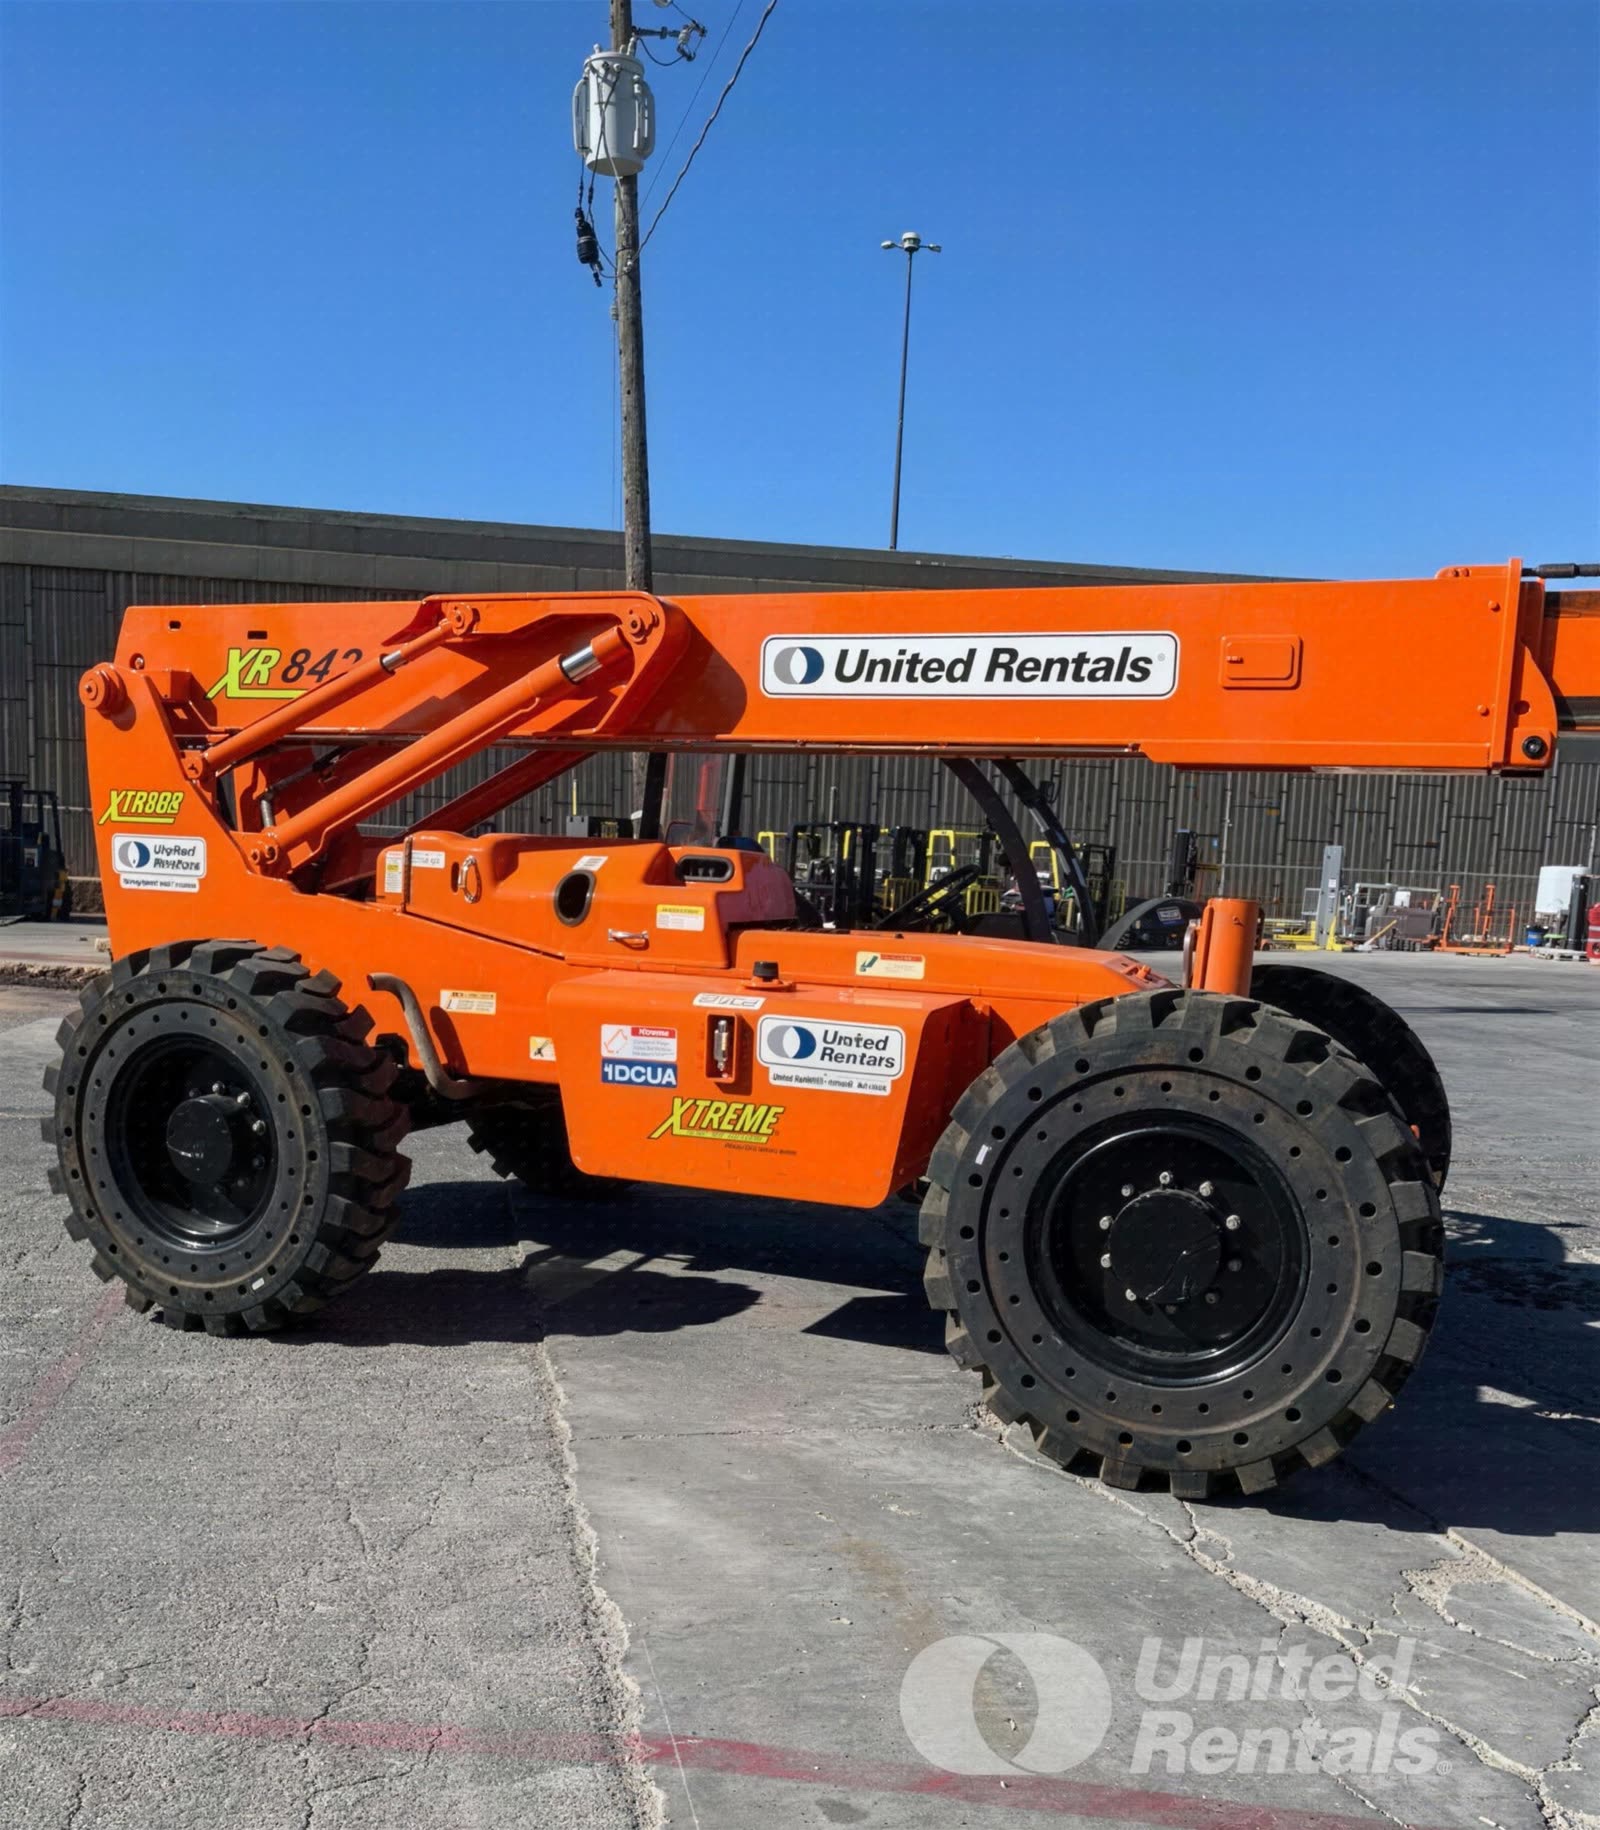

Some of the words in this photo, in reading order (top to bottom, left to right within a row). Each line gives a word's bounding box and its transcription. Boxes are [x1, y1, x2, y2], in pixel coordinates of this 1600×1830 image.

[834, 647, 977, 684] United
[984, 646, 1153, 684] Rentals
[648, 1096, 785, 1140] XTREME
